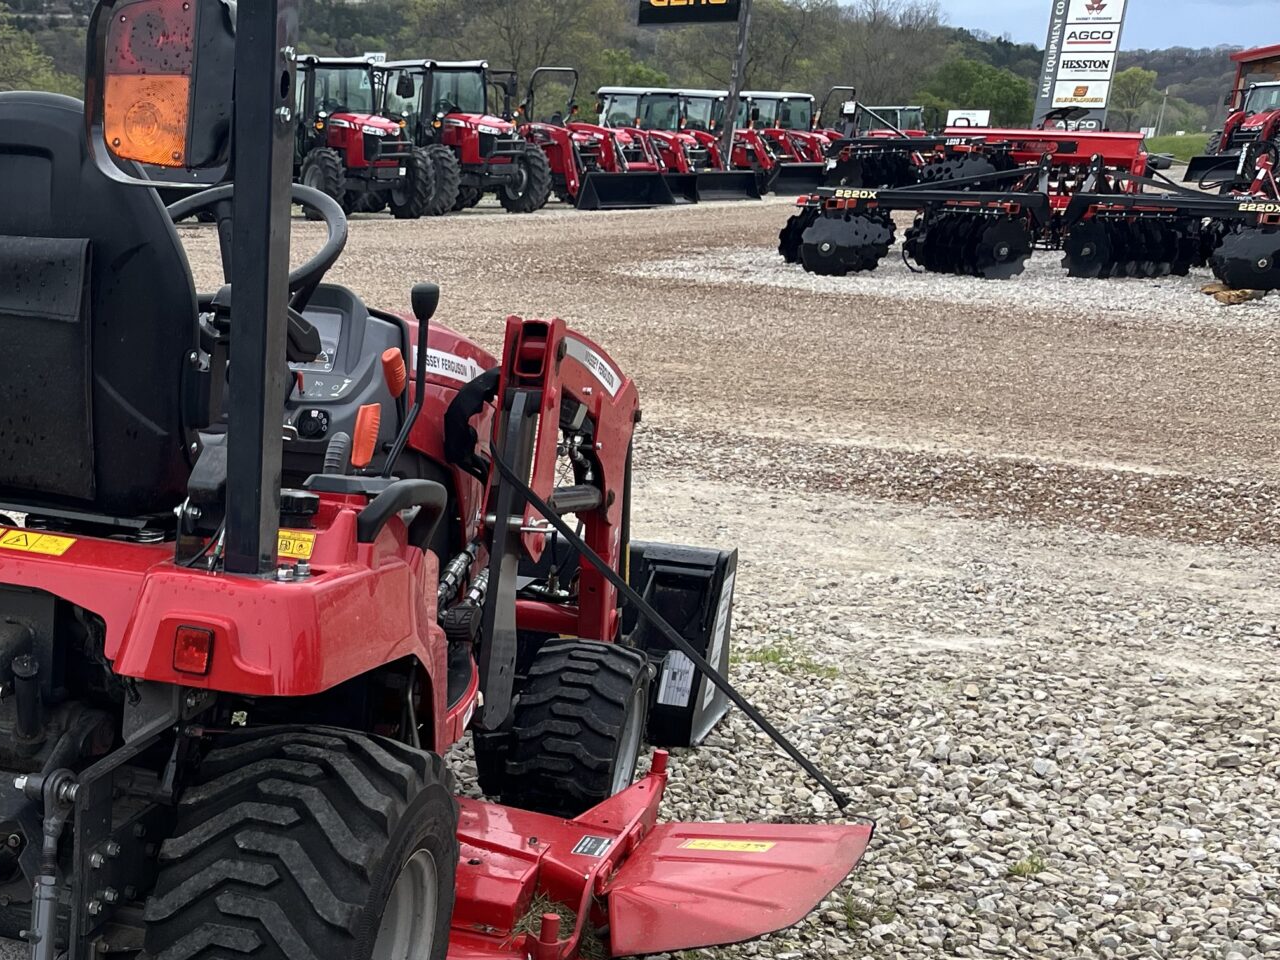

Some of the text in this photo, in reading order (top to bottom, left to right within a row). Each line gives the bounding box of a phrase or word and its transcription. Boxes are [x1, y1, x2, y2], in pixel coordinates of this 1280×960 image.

[1067, 30, 1113, 40] AGCO
[1041, 74, 1052, 98] LAUF
[1047, 19, 1063, 72] EQUIPMENT
[1062, 60, 1110, 69] HESSTON
[835, 189, 877, 199] 2220X
[441, 357, 467, 377] FERGUSON
